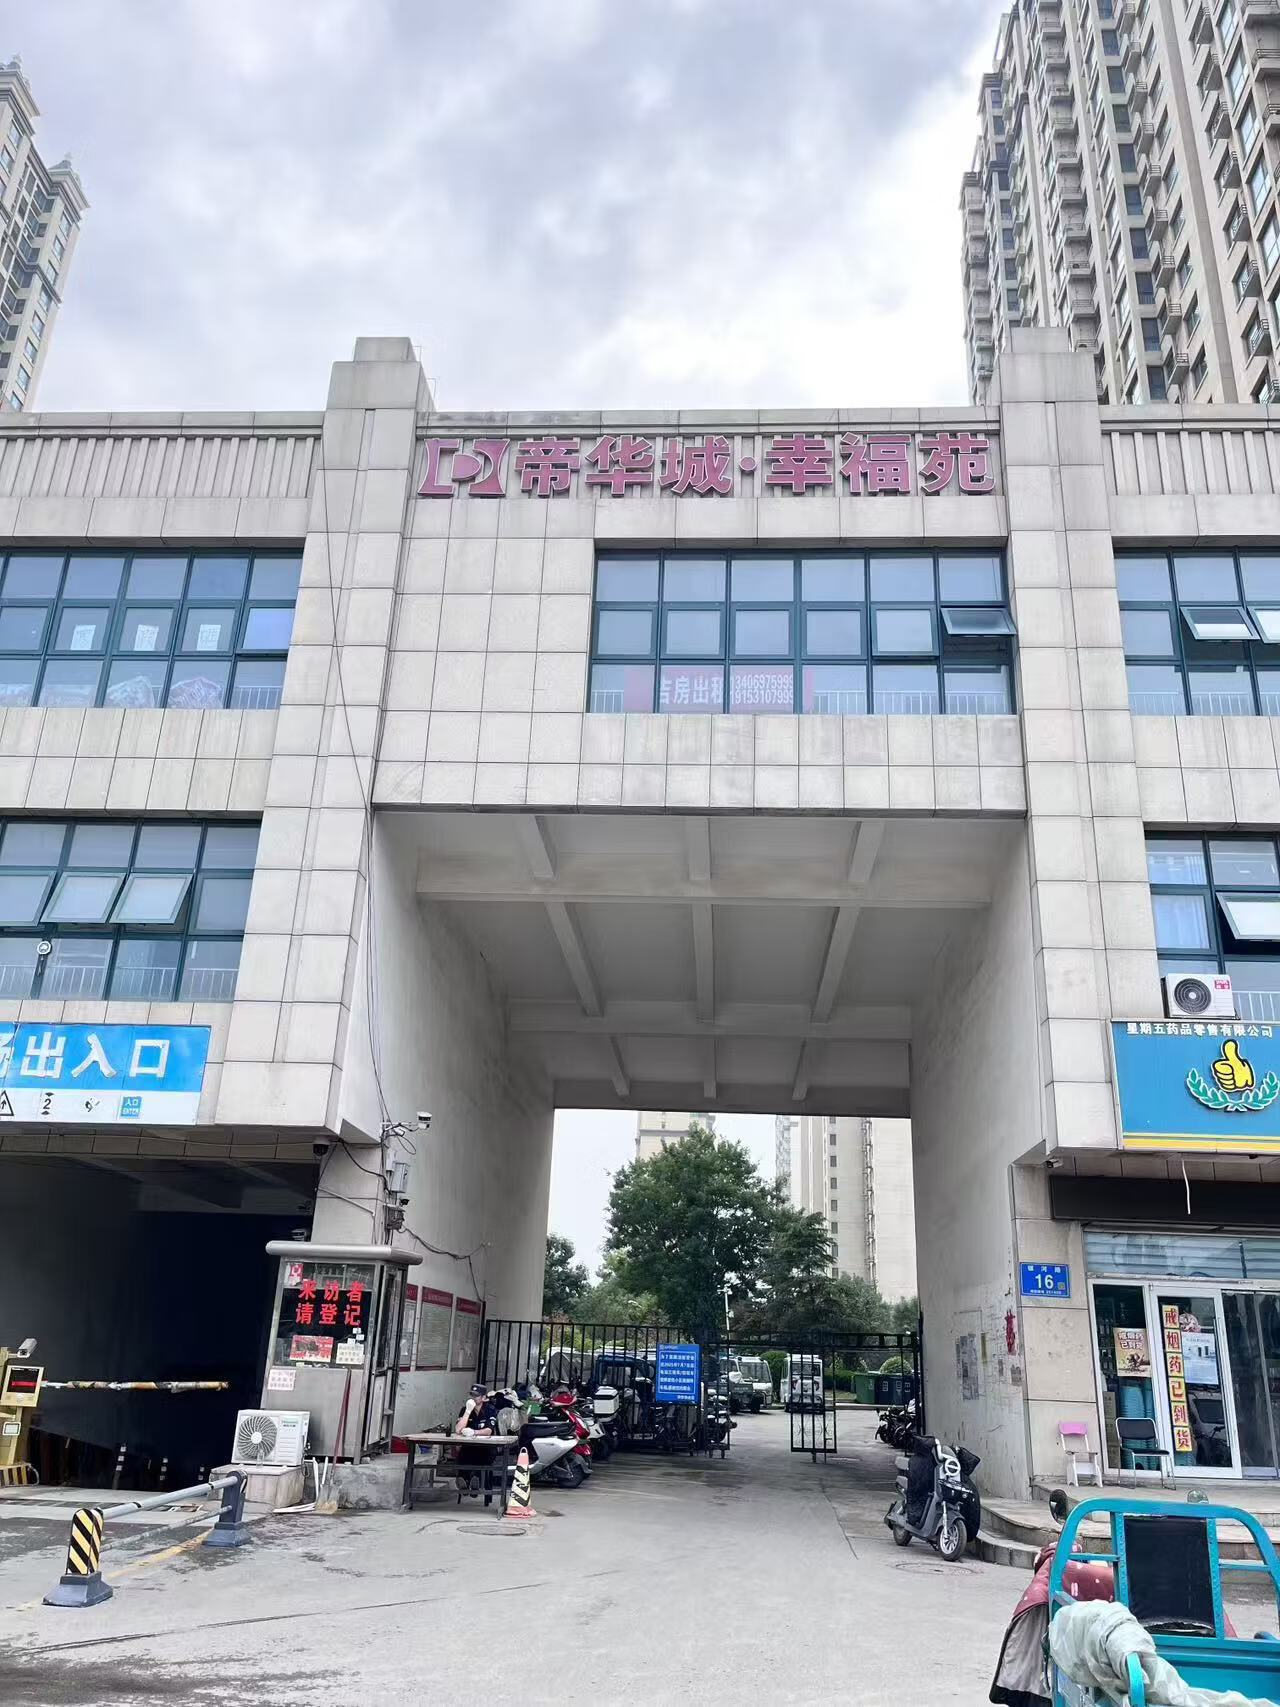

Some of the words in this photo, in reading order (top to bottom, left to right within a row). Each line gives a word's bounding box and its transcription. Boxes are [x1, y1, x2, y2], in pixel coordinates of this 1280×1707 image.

[514, 432, 996, 497] 帝华城·幸福苑
[1126, 1022, 1273, 1038] 星期五药品零售有限公司
[298, 1279, 365, 1303] 来访者
[1035, 1273, 1054, 1290] 16
[295, 1302, 361, 1326] 请登记
[1164, 1307, 1190, 1448] 戒烟药已到货
